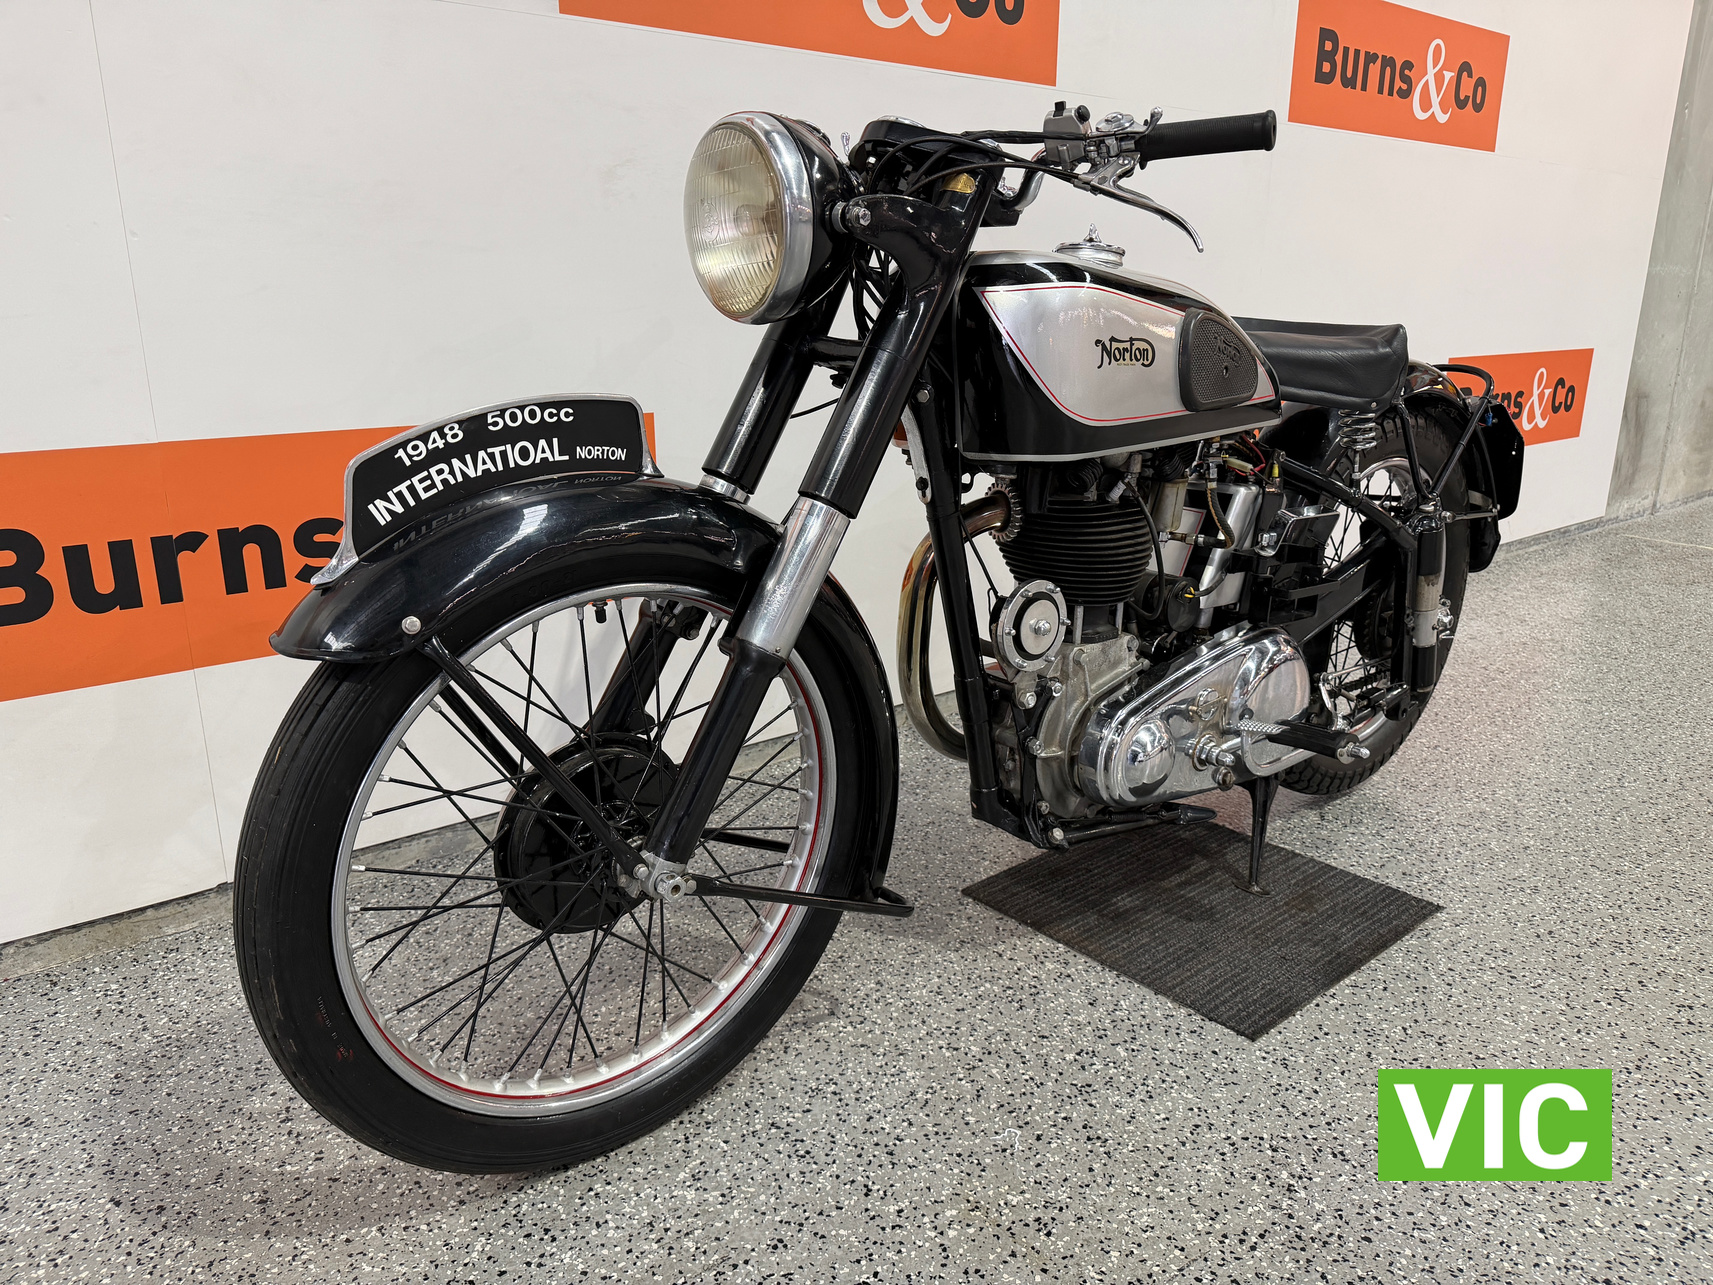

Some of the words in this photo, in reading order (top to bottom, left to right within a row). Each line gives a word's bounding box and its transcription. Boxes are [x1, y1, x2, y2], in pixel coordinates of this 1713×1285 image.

[1314, 27, 1487, 123] Burns&Co
[1095, 336, 1155, 369] Norton
[394, 422, 464, 467] 1948
[486, 405, 575, 431] 500cc
[367, 438, 570, 527] INTERNATIOAL
[576, 446, 627, 461] NORTON
